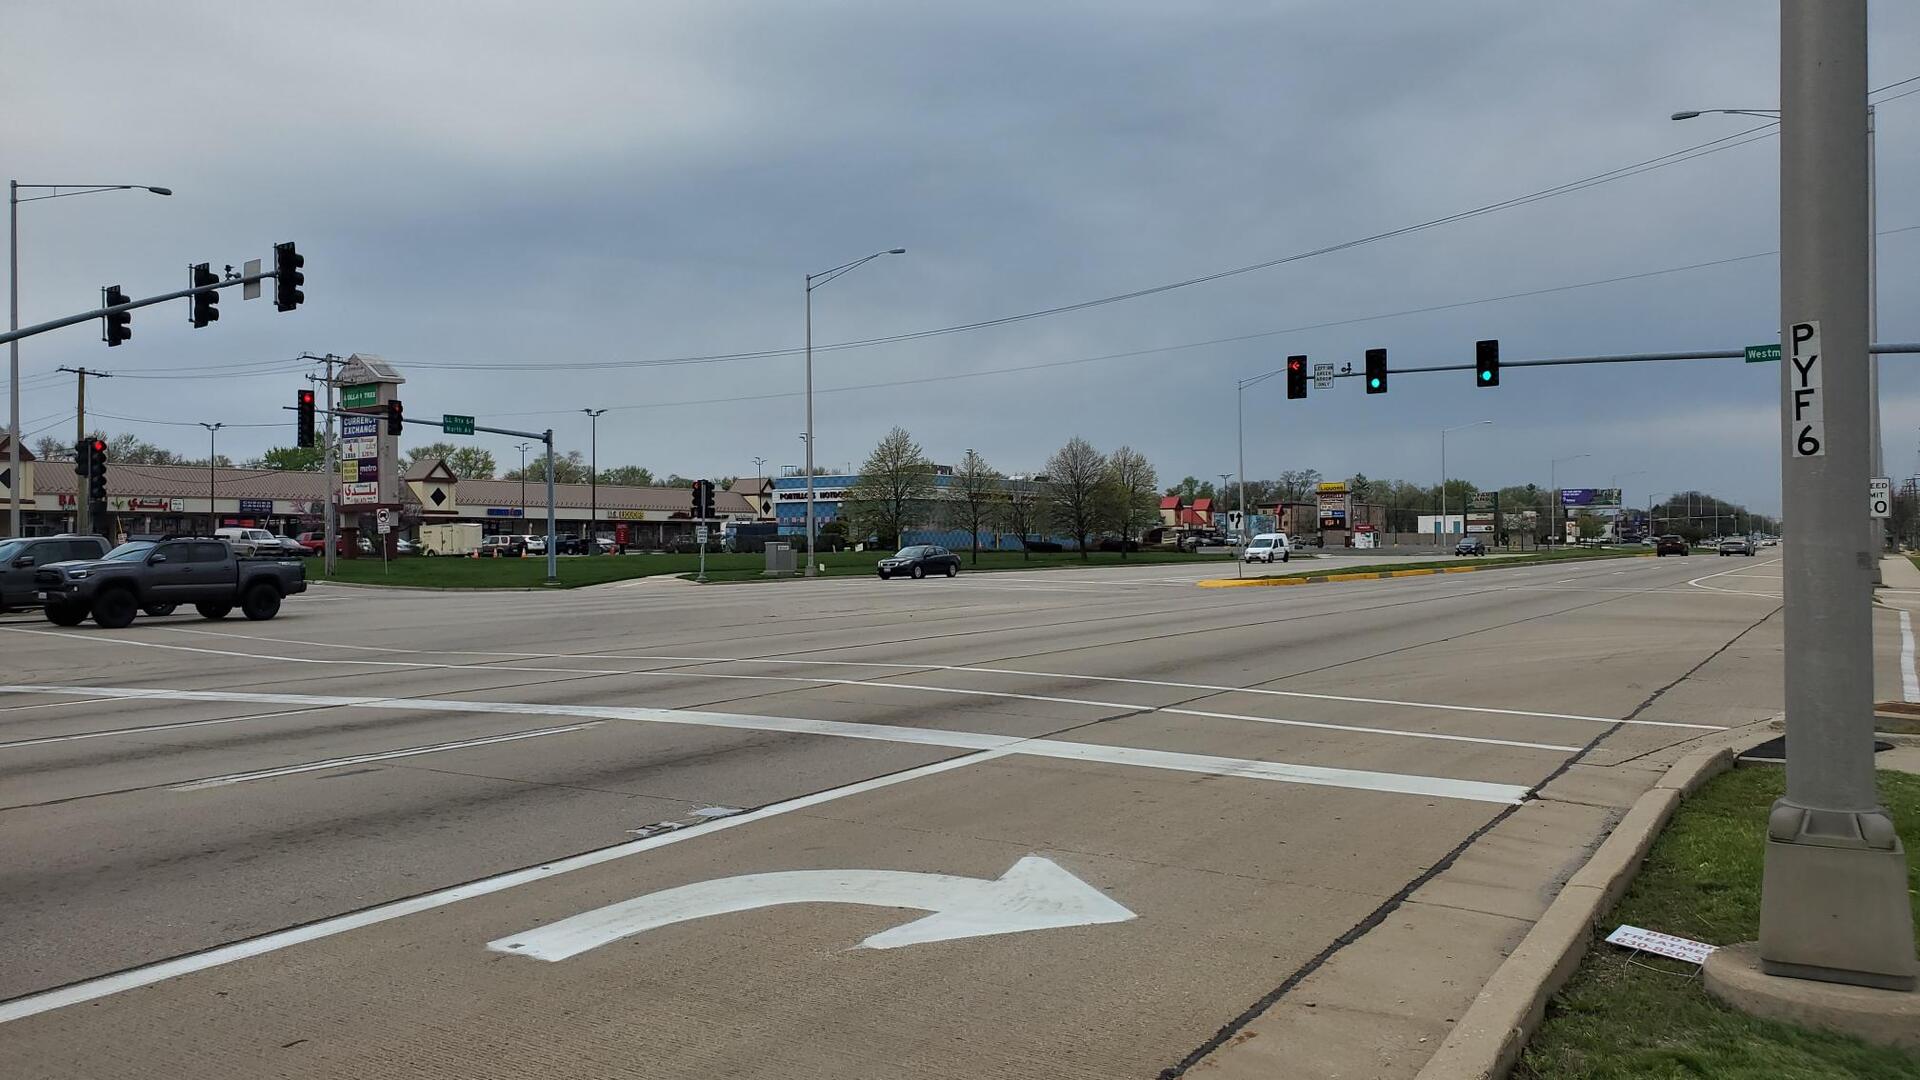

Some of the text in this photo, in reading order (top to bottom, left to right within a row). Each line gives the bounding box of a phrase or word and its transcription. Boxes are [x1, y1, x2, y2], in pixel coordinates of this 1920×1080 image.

[1748, 349, 1781, 359] Westm
[1792, 323, 1820, 456] PYF6
[343, 416, 377, 425] CURRENCY
[343, 424, 377, 435] EXCHANGE
[359, 464, 377, 472] metro
[779, 492, 816, 500] PORTILLOS
[1870, 500, 1888, 514] 0
[1646, 931, 1682, 942] BED
